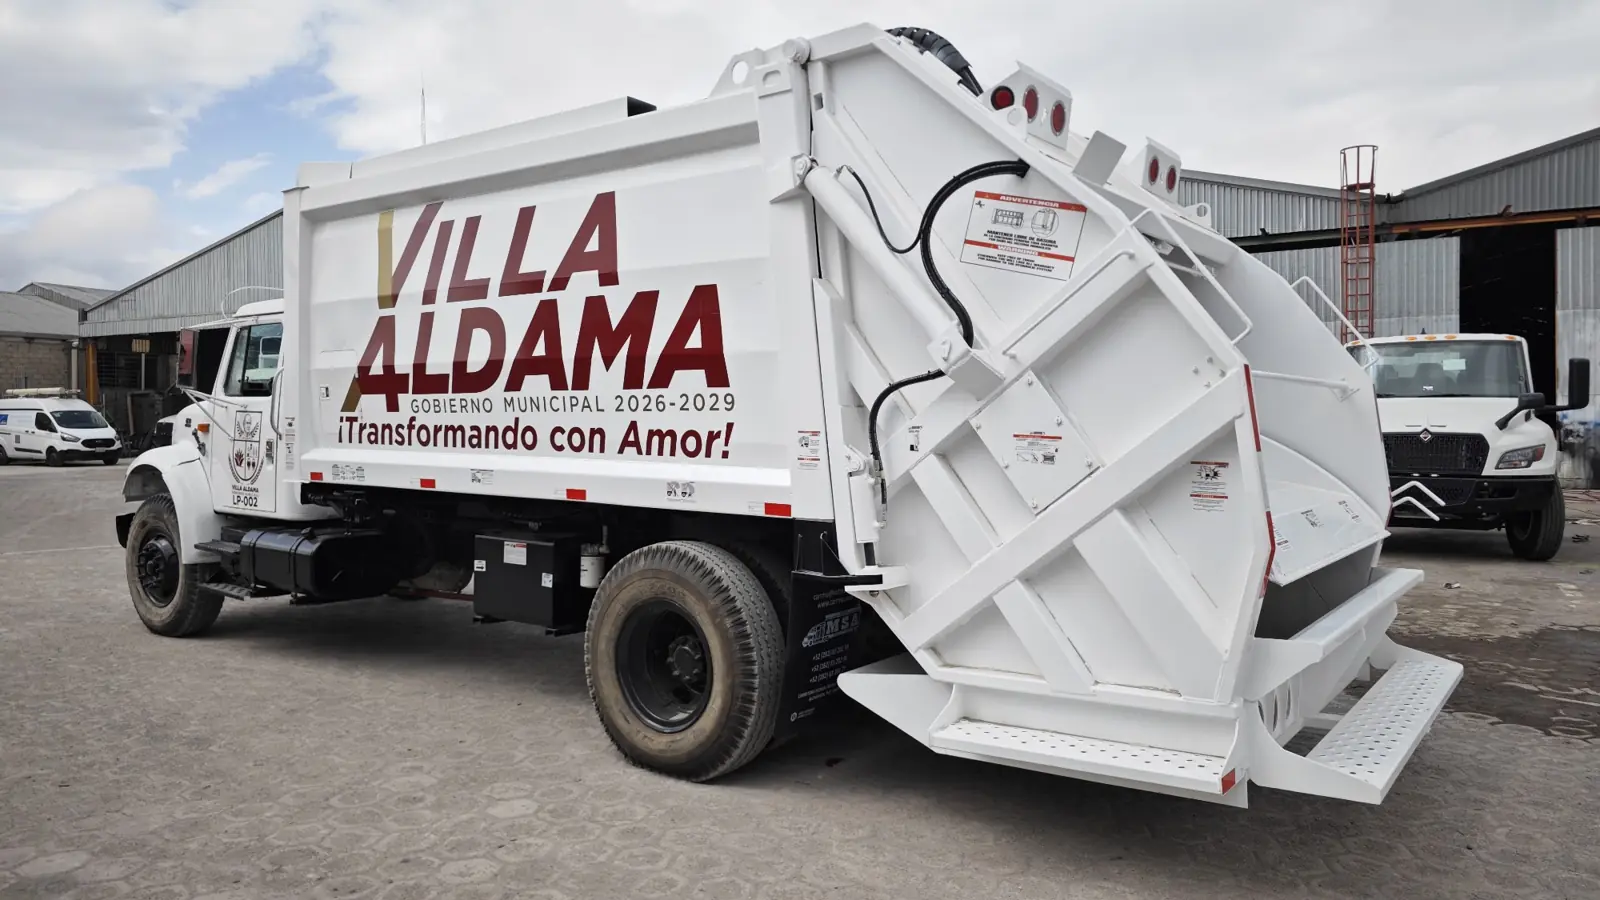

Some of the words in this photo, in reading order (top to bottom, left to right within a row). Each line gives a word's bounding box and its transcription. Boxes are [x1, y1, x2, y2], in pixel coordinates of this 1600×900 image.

[999, 195, 1059, 208] ADVERTENCIA
[377, 190, 620, 310] VILLA
[998, 244, 1039, 256] WARNING
[341, 283, 731, 413] ALDAMA
[410, 397, 493, 414] GOBIERNO
[503, 395, 605, 413] MUNICIPAL
[614, 392, 736, 413] 2026-2029
[338, 416, 538, 451] ¡Transformando
[549, 426, 606, 453] con
[617, 420, 735, 459] Amor!
[232, 495, 258, 507] LP-002
